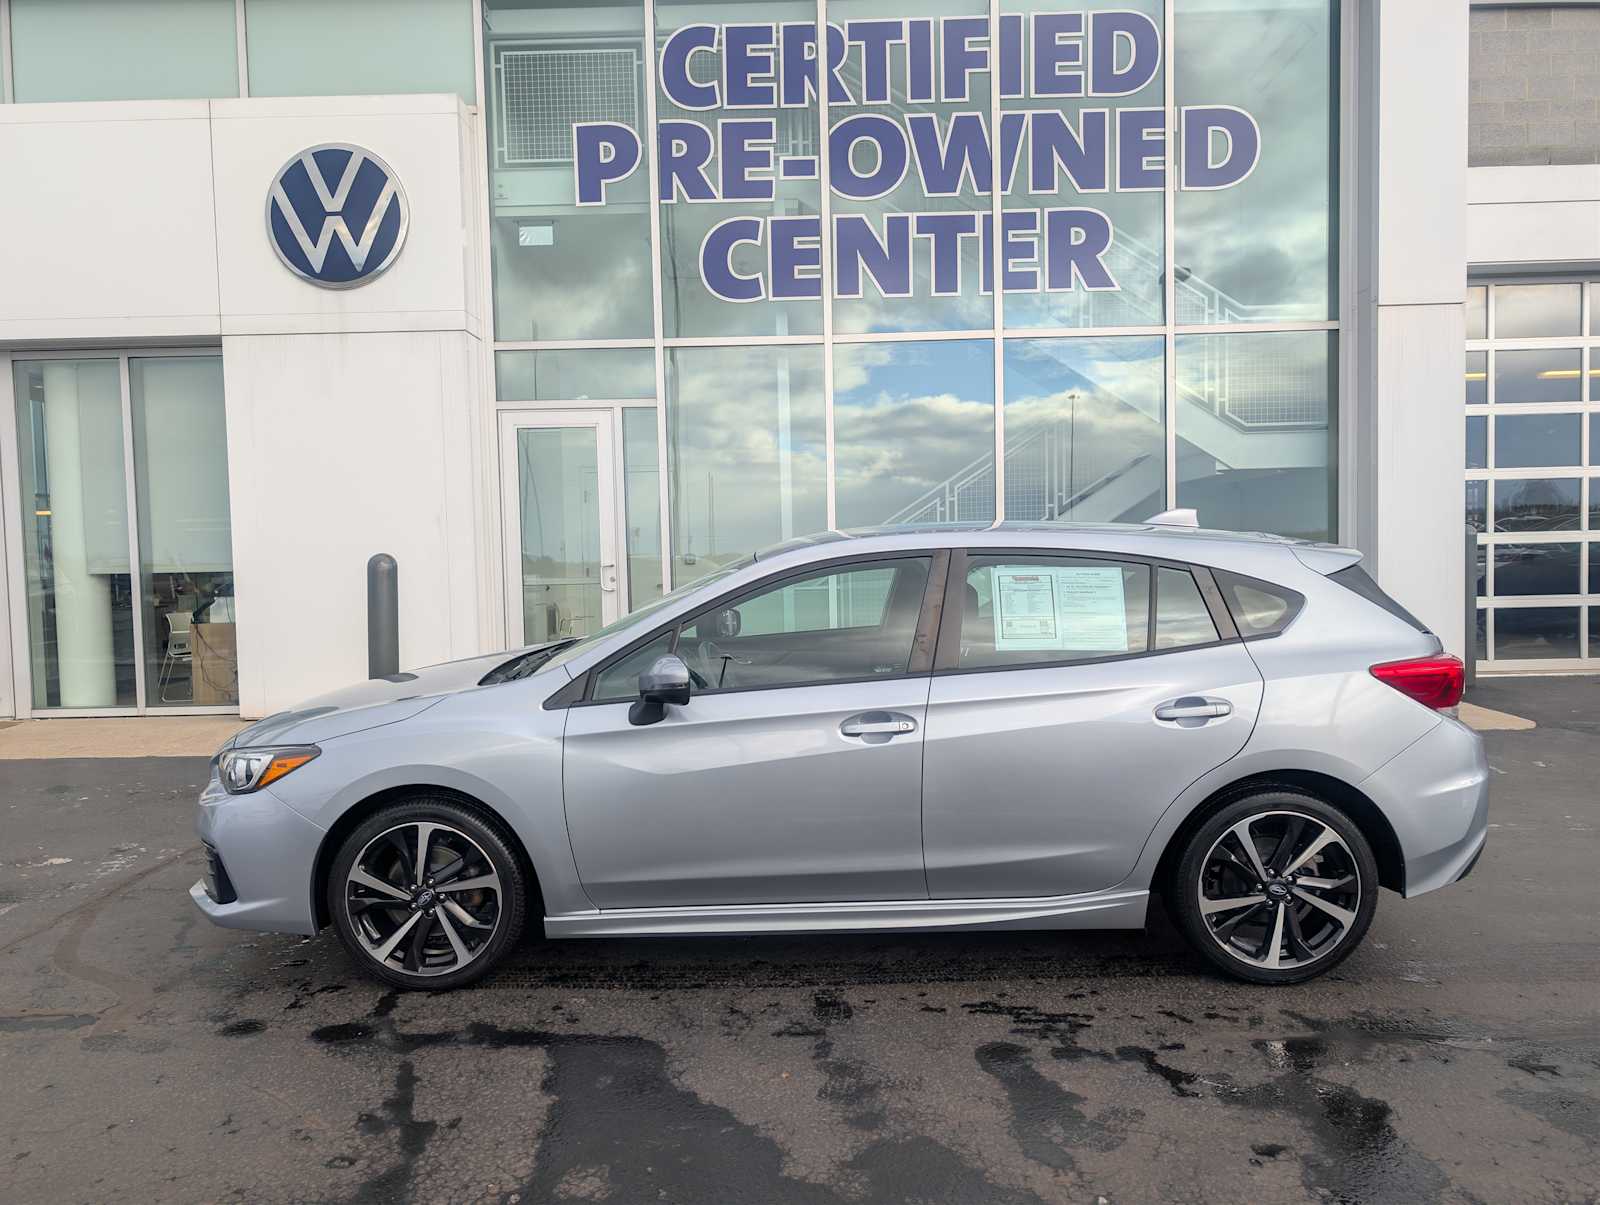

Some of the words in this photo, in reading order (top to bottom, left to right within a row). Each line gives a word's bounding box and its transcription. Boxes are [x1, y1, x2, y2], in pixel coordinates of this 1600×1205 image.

[658, 10, 1161, 111] CERTIFIED
[572, 105, 1261, 207] PRE-OWNED
[700, 207, 1121, 303] CENTER
